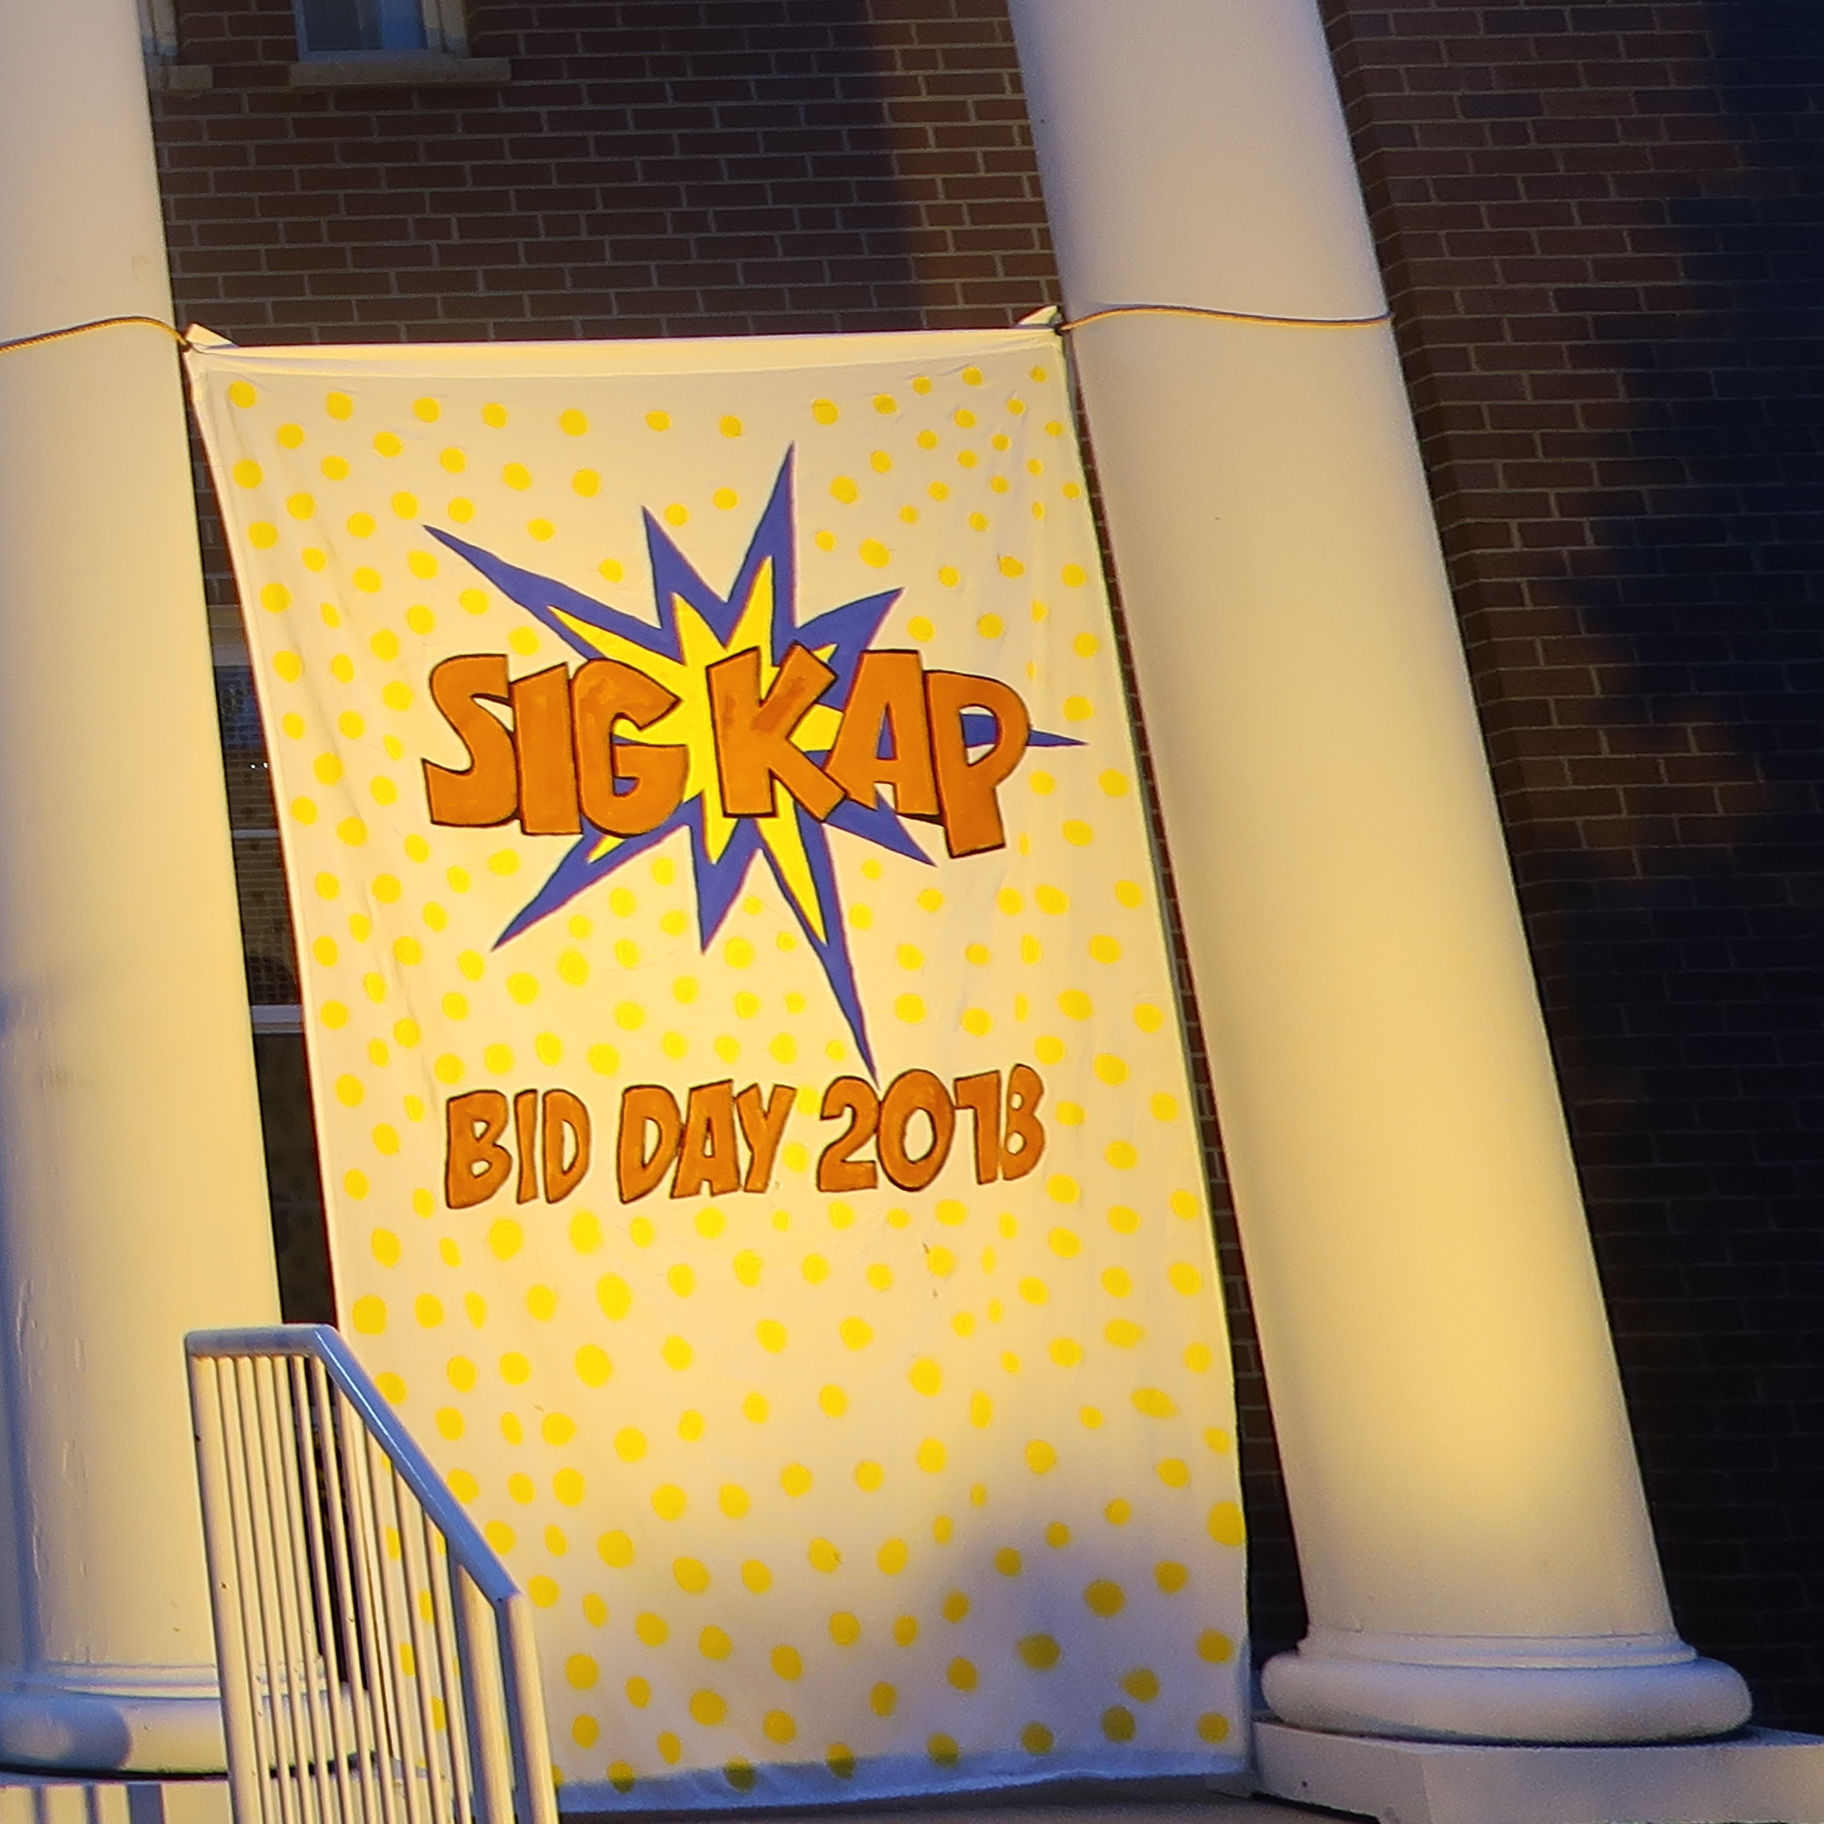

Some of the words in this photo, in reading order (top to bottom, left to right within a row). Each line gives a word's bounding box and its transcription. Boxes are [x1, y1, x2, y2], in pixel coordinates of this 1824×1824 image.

[420, 652, 690, 838] SIG
[705, 640, 1032, 859] KAP
[444, 1088, 591, 1210] BID
[616, 1078, 798, 1205] DAY
[816, 1063, 1045, 1193] 2018
